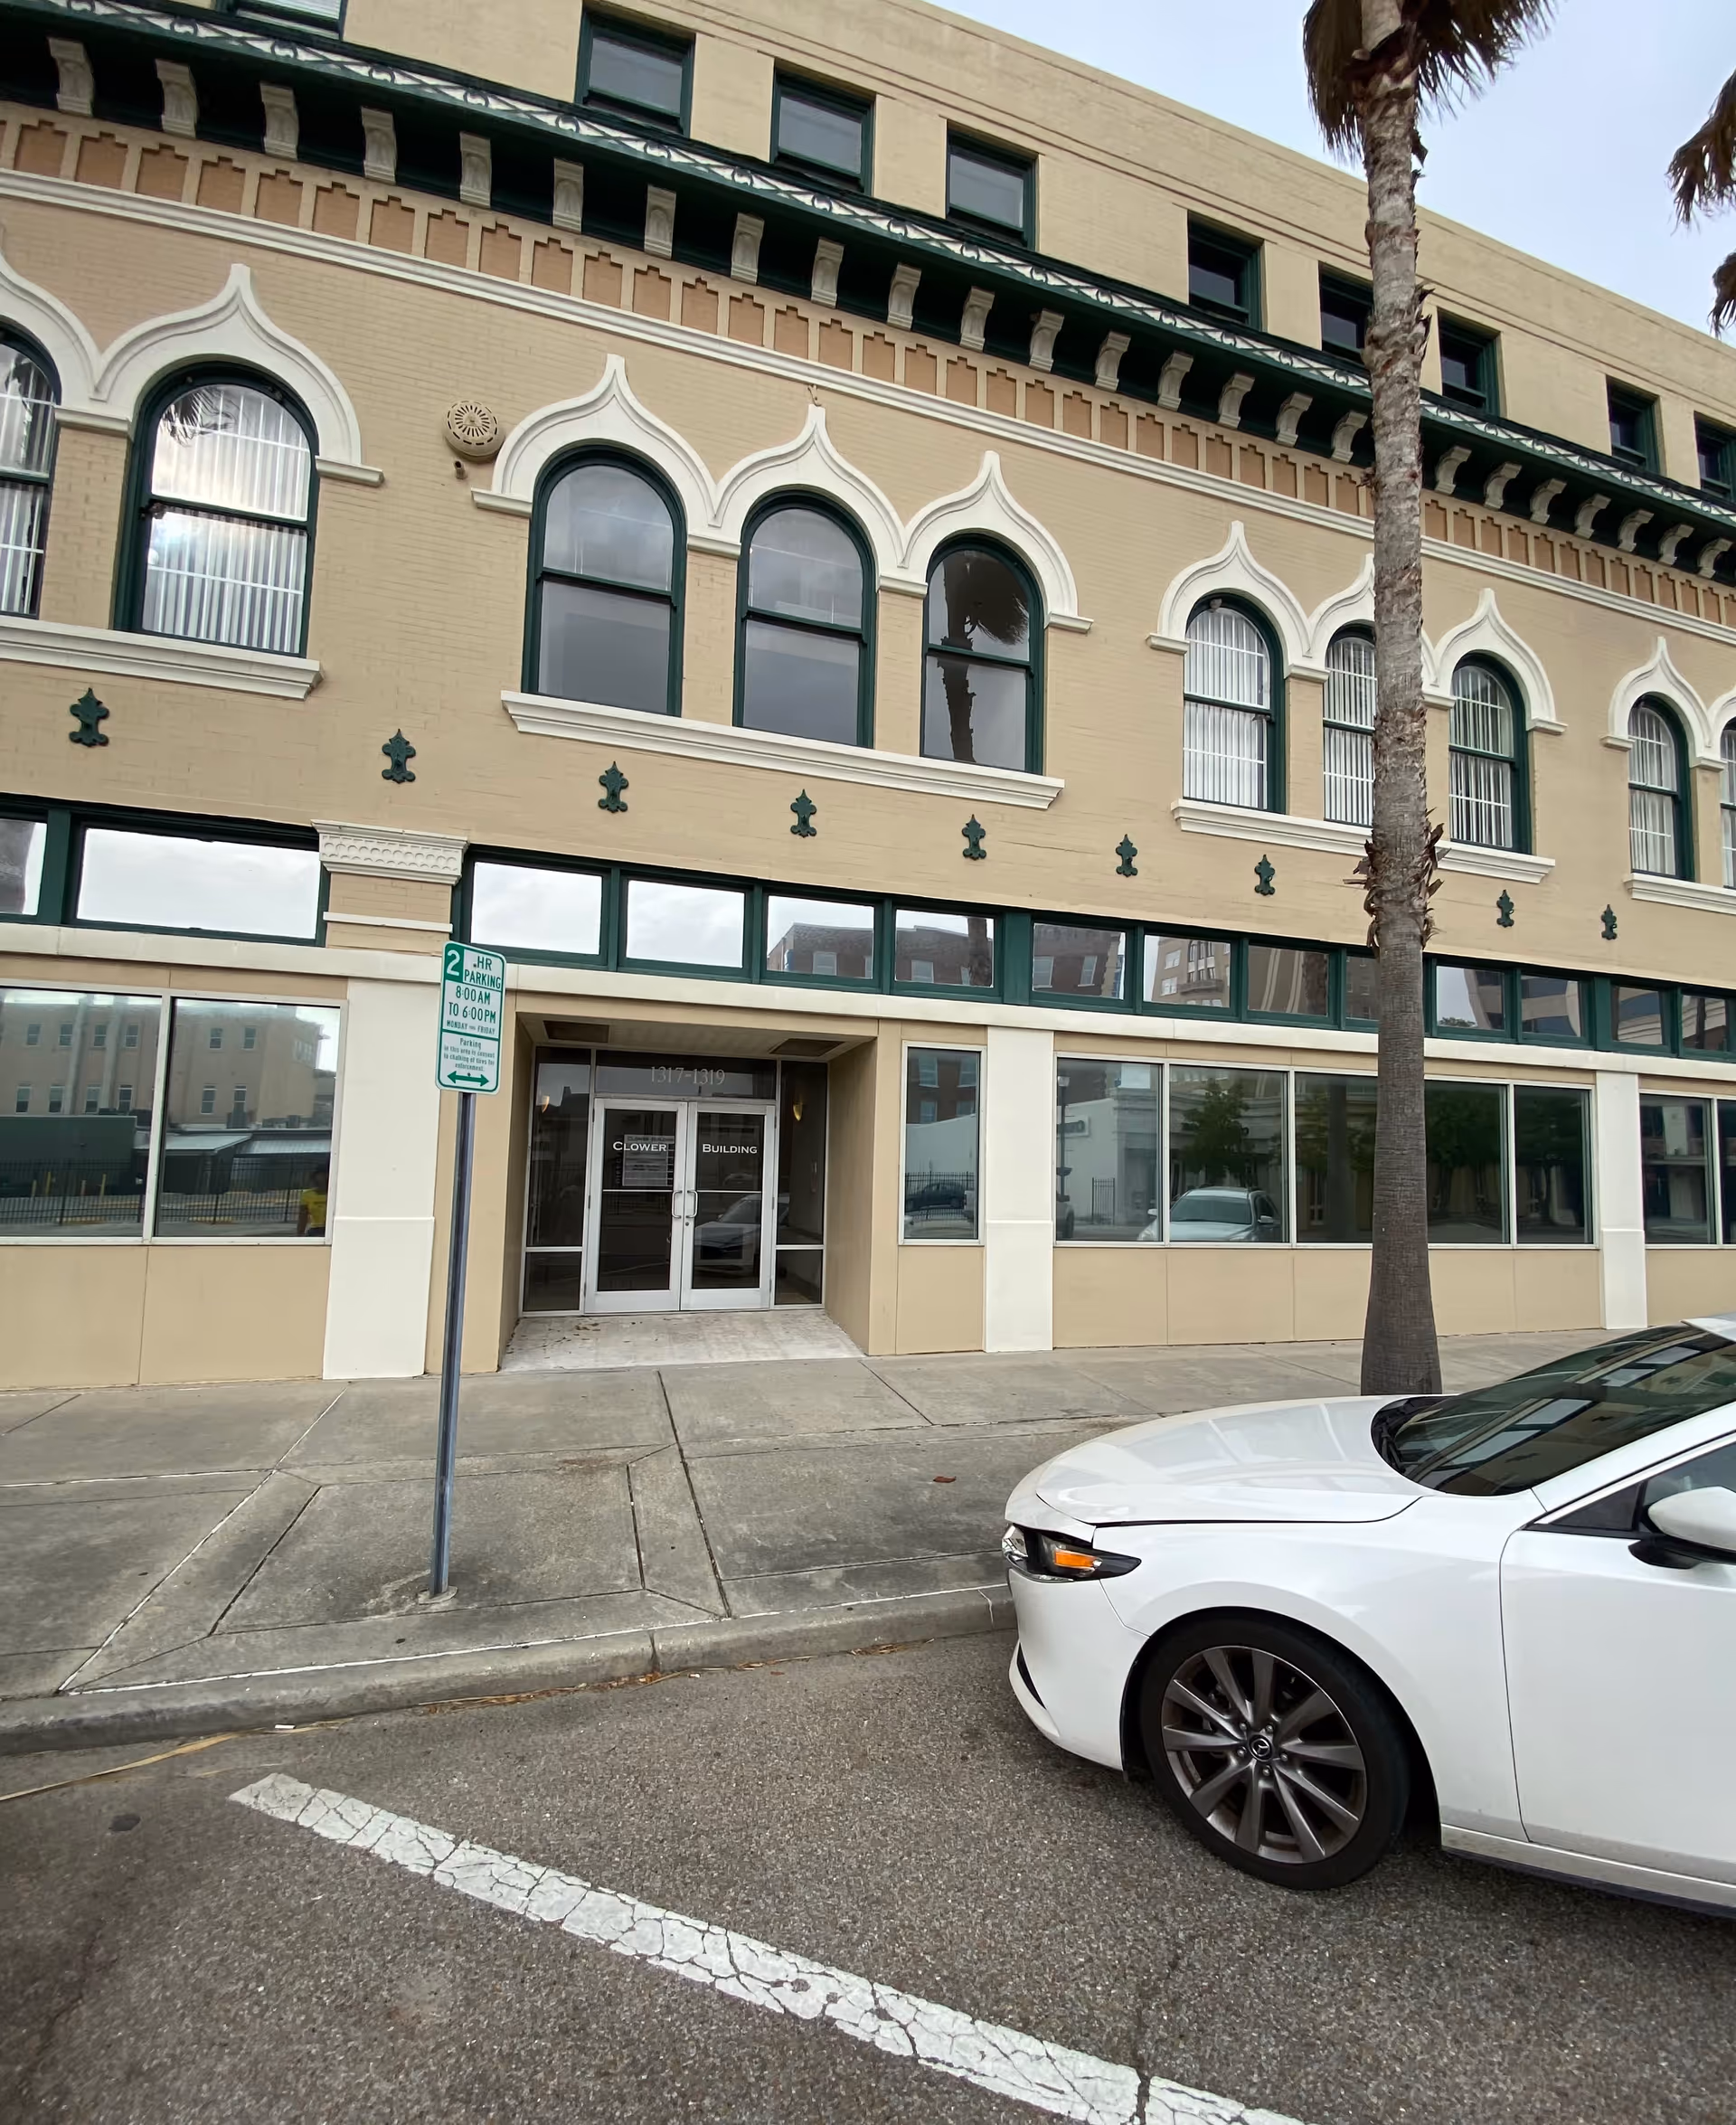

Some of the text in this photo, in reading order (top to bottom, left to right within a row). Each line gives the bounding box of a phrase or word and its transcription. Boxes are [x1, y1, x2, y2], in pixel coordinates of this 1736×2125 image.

[447, 949, 493, 977] 2 HR
[464, 968, 502, 989] PARKING
[448, 1001, 459, 1016] TO
[447, 1020, 467, 1030] MONDAY
[477, 1025, 495, 1034] FRIDAY
[460, 1038, 481, 1051] Parking
[651, 1066, 725, 1085] 1317-1319
